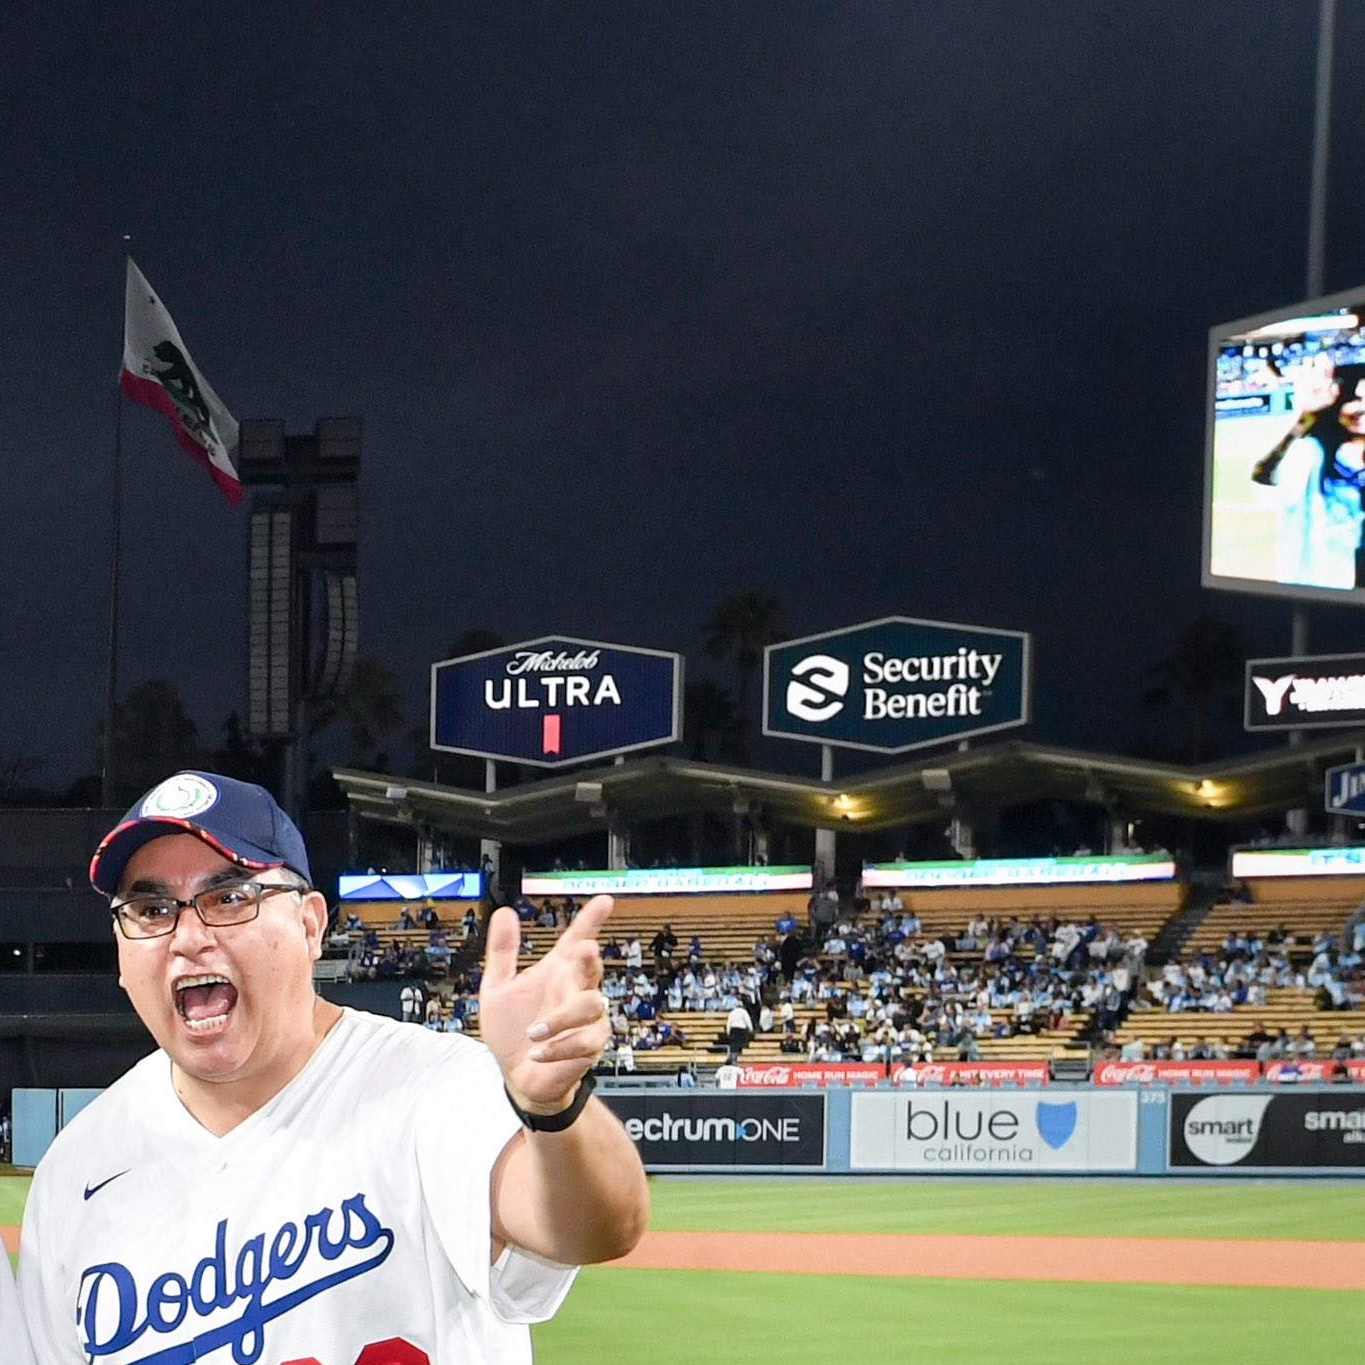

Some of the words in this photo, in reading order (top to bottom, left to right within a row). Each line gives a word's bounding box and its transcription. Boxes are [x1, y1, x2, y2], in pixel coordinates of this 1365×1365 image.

[505, 649, 602, 674] Michelob
[862, 647, 1003, 688] Security
[484, 674, 622, 710] ULTRA
[862, 684, 983, 720] Benefit
[792, 1070, 823, 1081] HOME
[824, 1070, 845, 1080] RUN
[846, 1069, 879, 1080] MAGIC
[980, 1069, 1016, 1079] EVERY
[1018, 1068, 1045, 1079] TIME
[624, 1112, 736, 1142] ectrum
[740, 1117, 801, 1143] ONE
[905, 1099, 1020, 1141] blue
[1188, 1117, 1254, 1136] smart
[923, 1143, 1033, 1163] california
